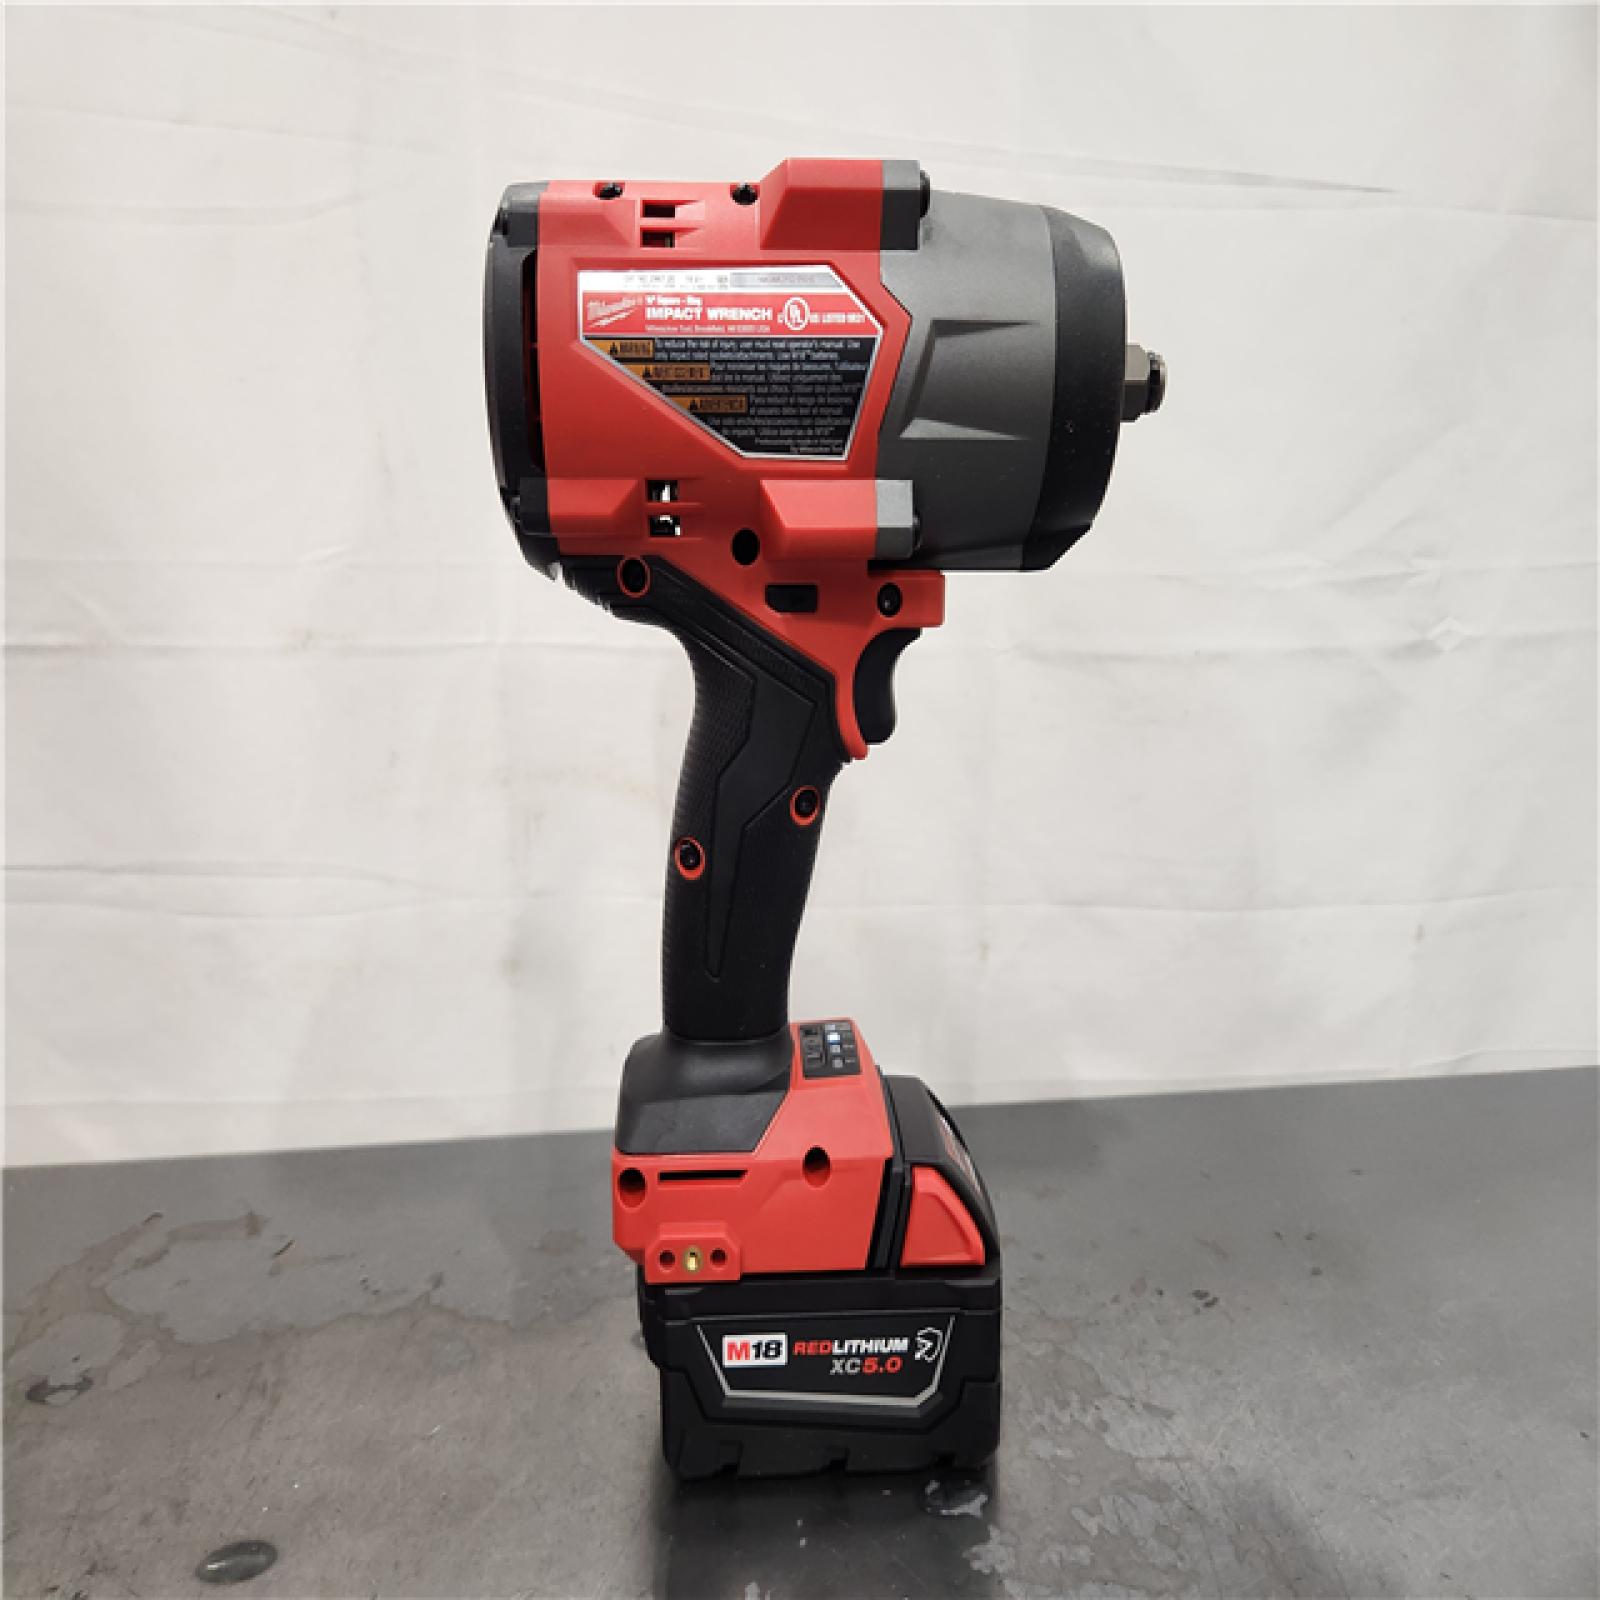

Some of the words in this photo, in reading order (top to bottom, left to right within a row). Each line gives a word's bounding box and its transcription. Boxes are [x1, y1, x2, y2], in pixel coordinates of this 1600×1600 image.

[644, 306, 702, 320] IMPACT
[706, 306, 773, 321] WRENCH
[727, 1340, 783, 1362] M18
[793, 1337, 909, 1355] REDLITHIUM
[830, 1356, 903, 1375] XC5.0
